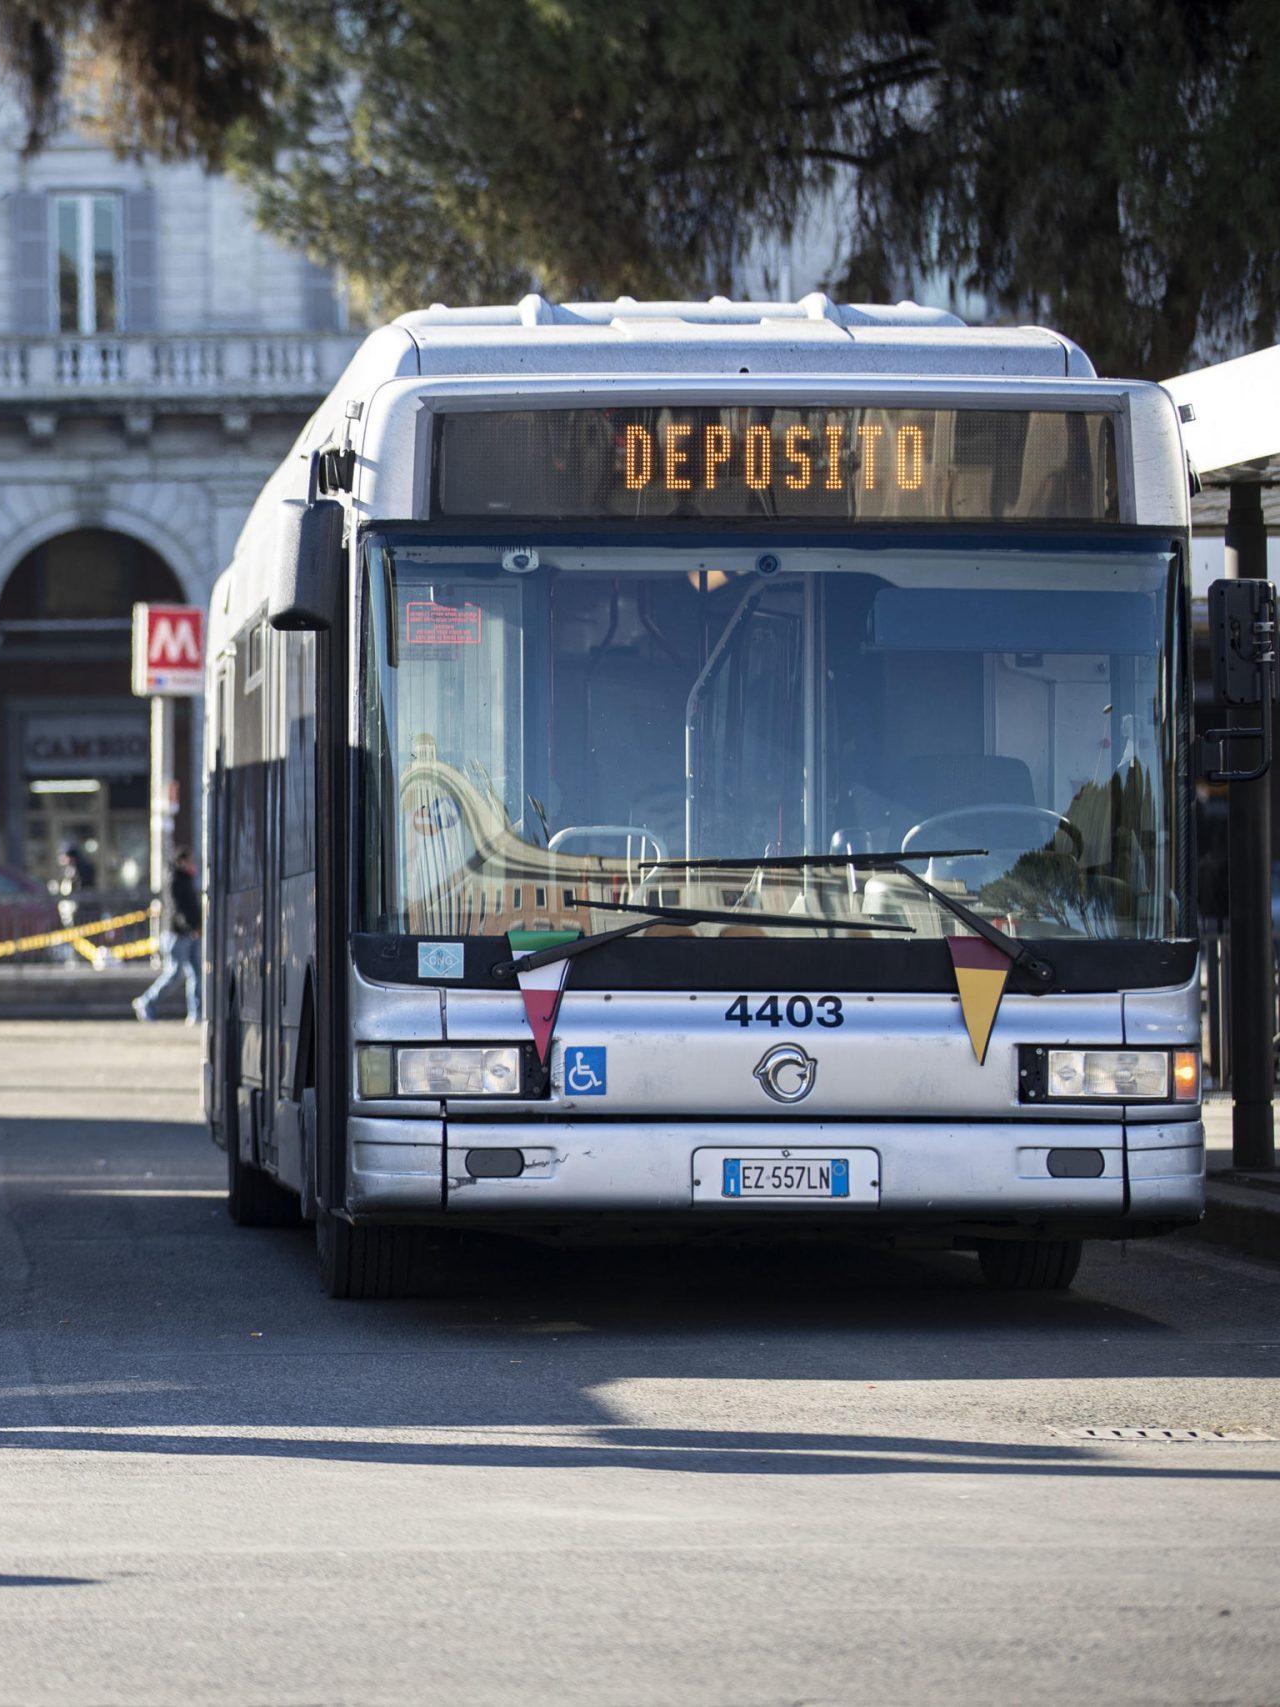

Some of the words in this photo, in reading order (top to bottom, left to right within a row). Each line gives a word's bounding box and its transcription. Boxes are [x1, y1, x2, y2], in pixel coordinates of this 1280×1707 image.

[626, 425, 922, 490] DEPOSITO
[148, 617, 198, 662] M
[724, 994, 845, 1029] 4403
